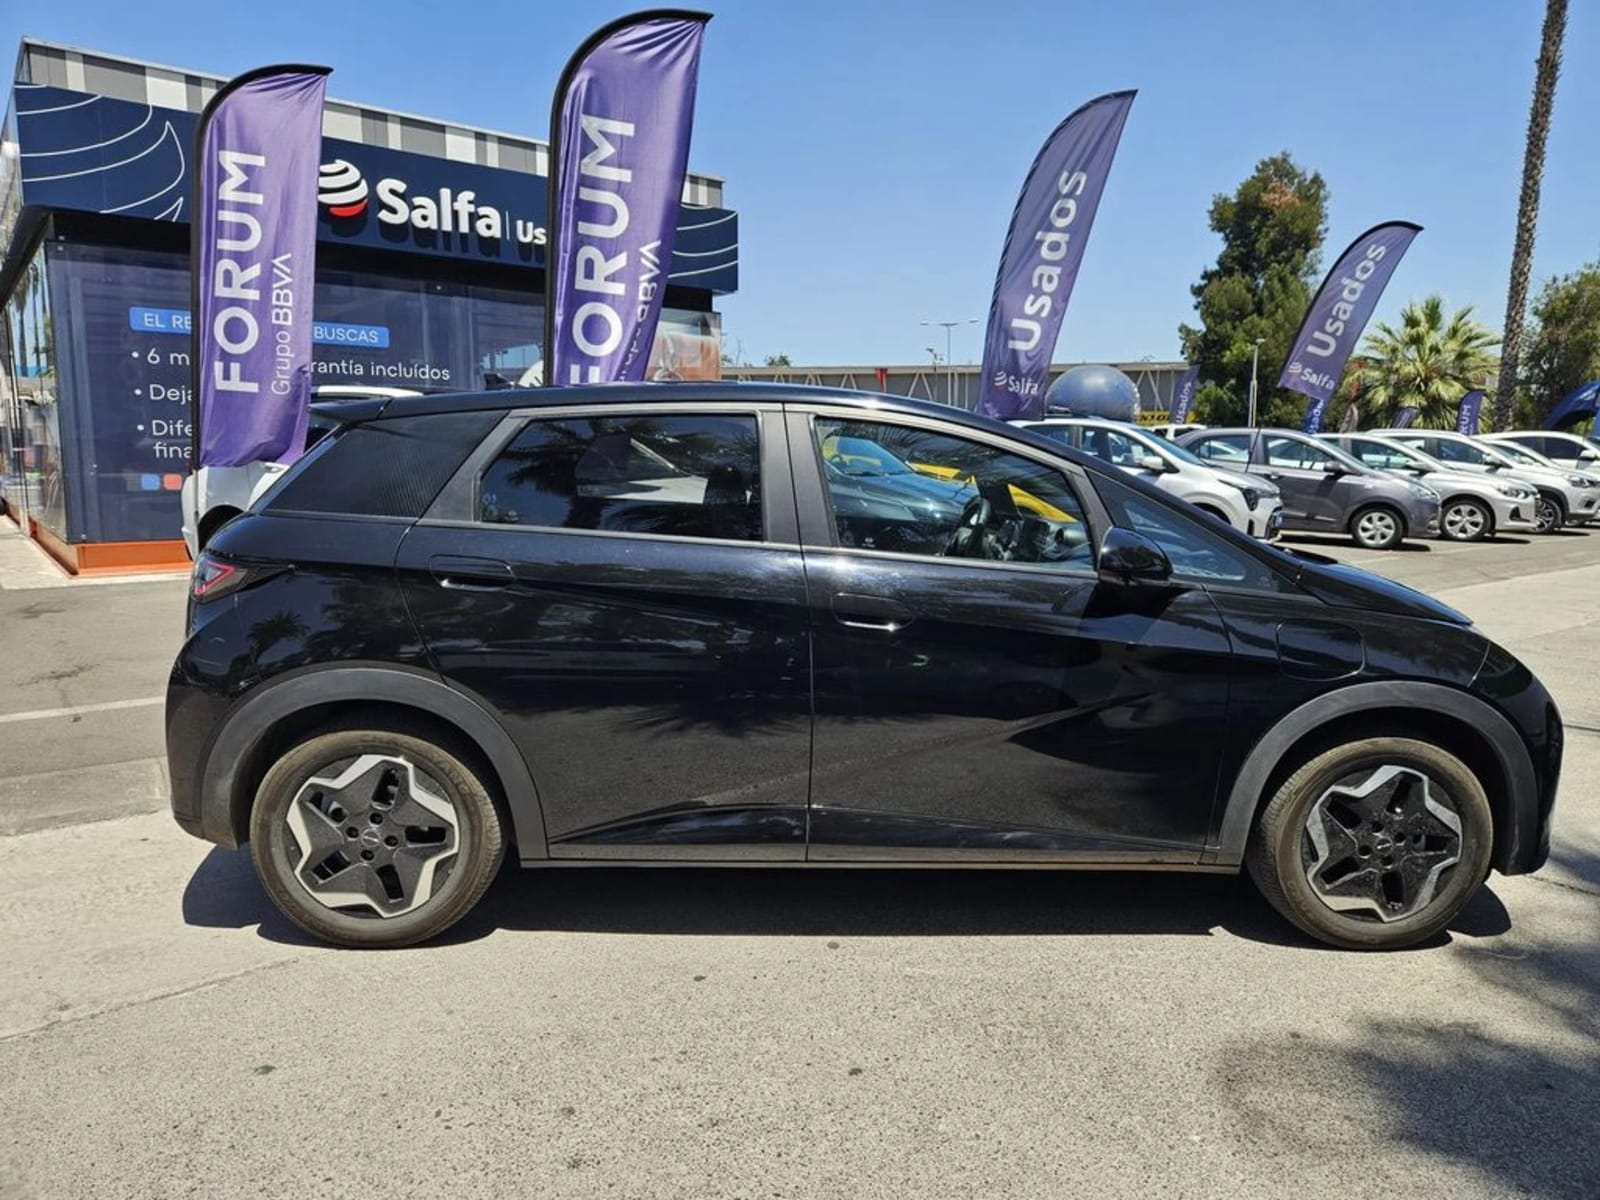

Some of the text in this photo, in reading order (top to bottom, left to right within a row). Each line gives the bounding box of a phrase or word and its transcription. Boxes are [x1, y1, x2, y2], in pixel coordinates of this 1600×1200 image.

[376, 178, 547, 245] Salfa Us
[214, 150, 266, 393] FORUM
[1008, 169, 1087, 352] Usados
[1306, 243, 1387, 358] Usados
[143, 312, 166, 328] EL
[271, 253, 294, 396] Grupo BBVA
[313, 326, 379, 344] BUSCAS
[147, 347, 160, 365] 6
[370, 361, 450, 381] incluídos
[1300, 367, 1336, 390] Salfa
[1007, 375, 1039, 396] Salfa
